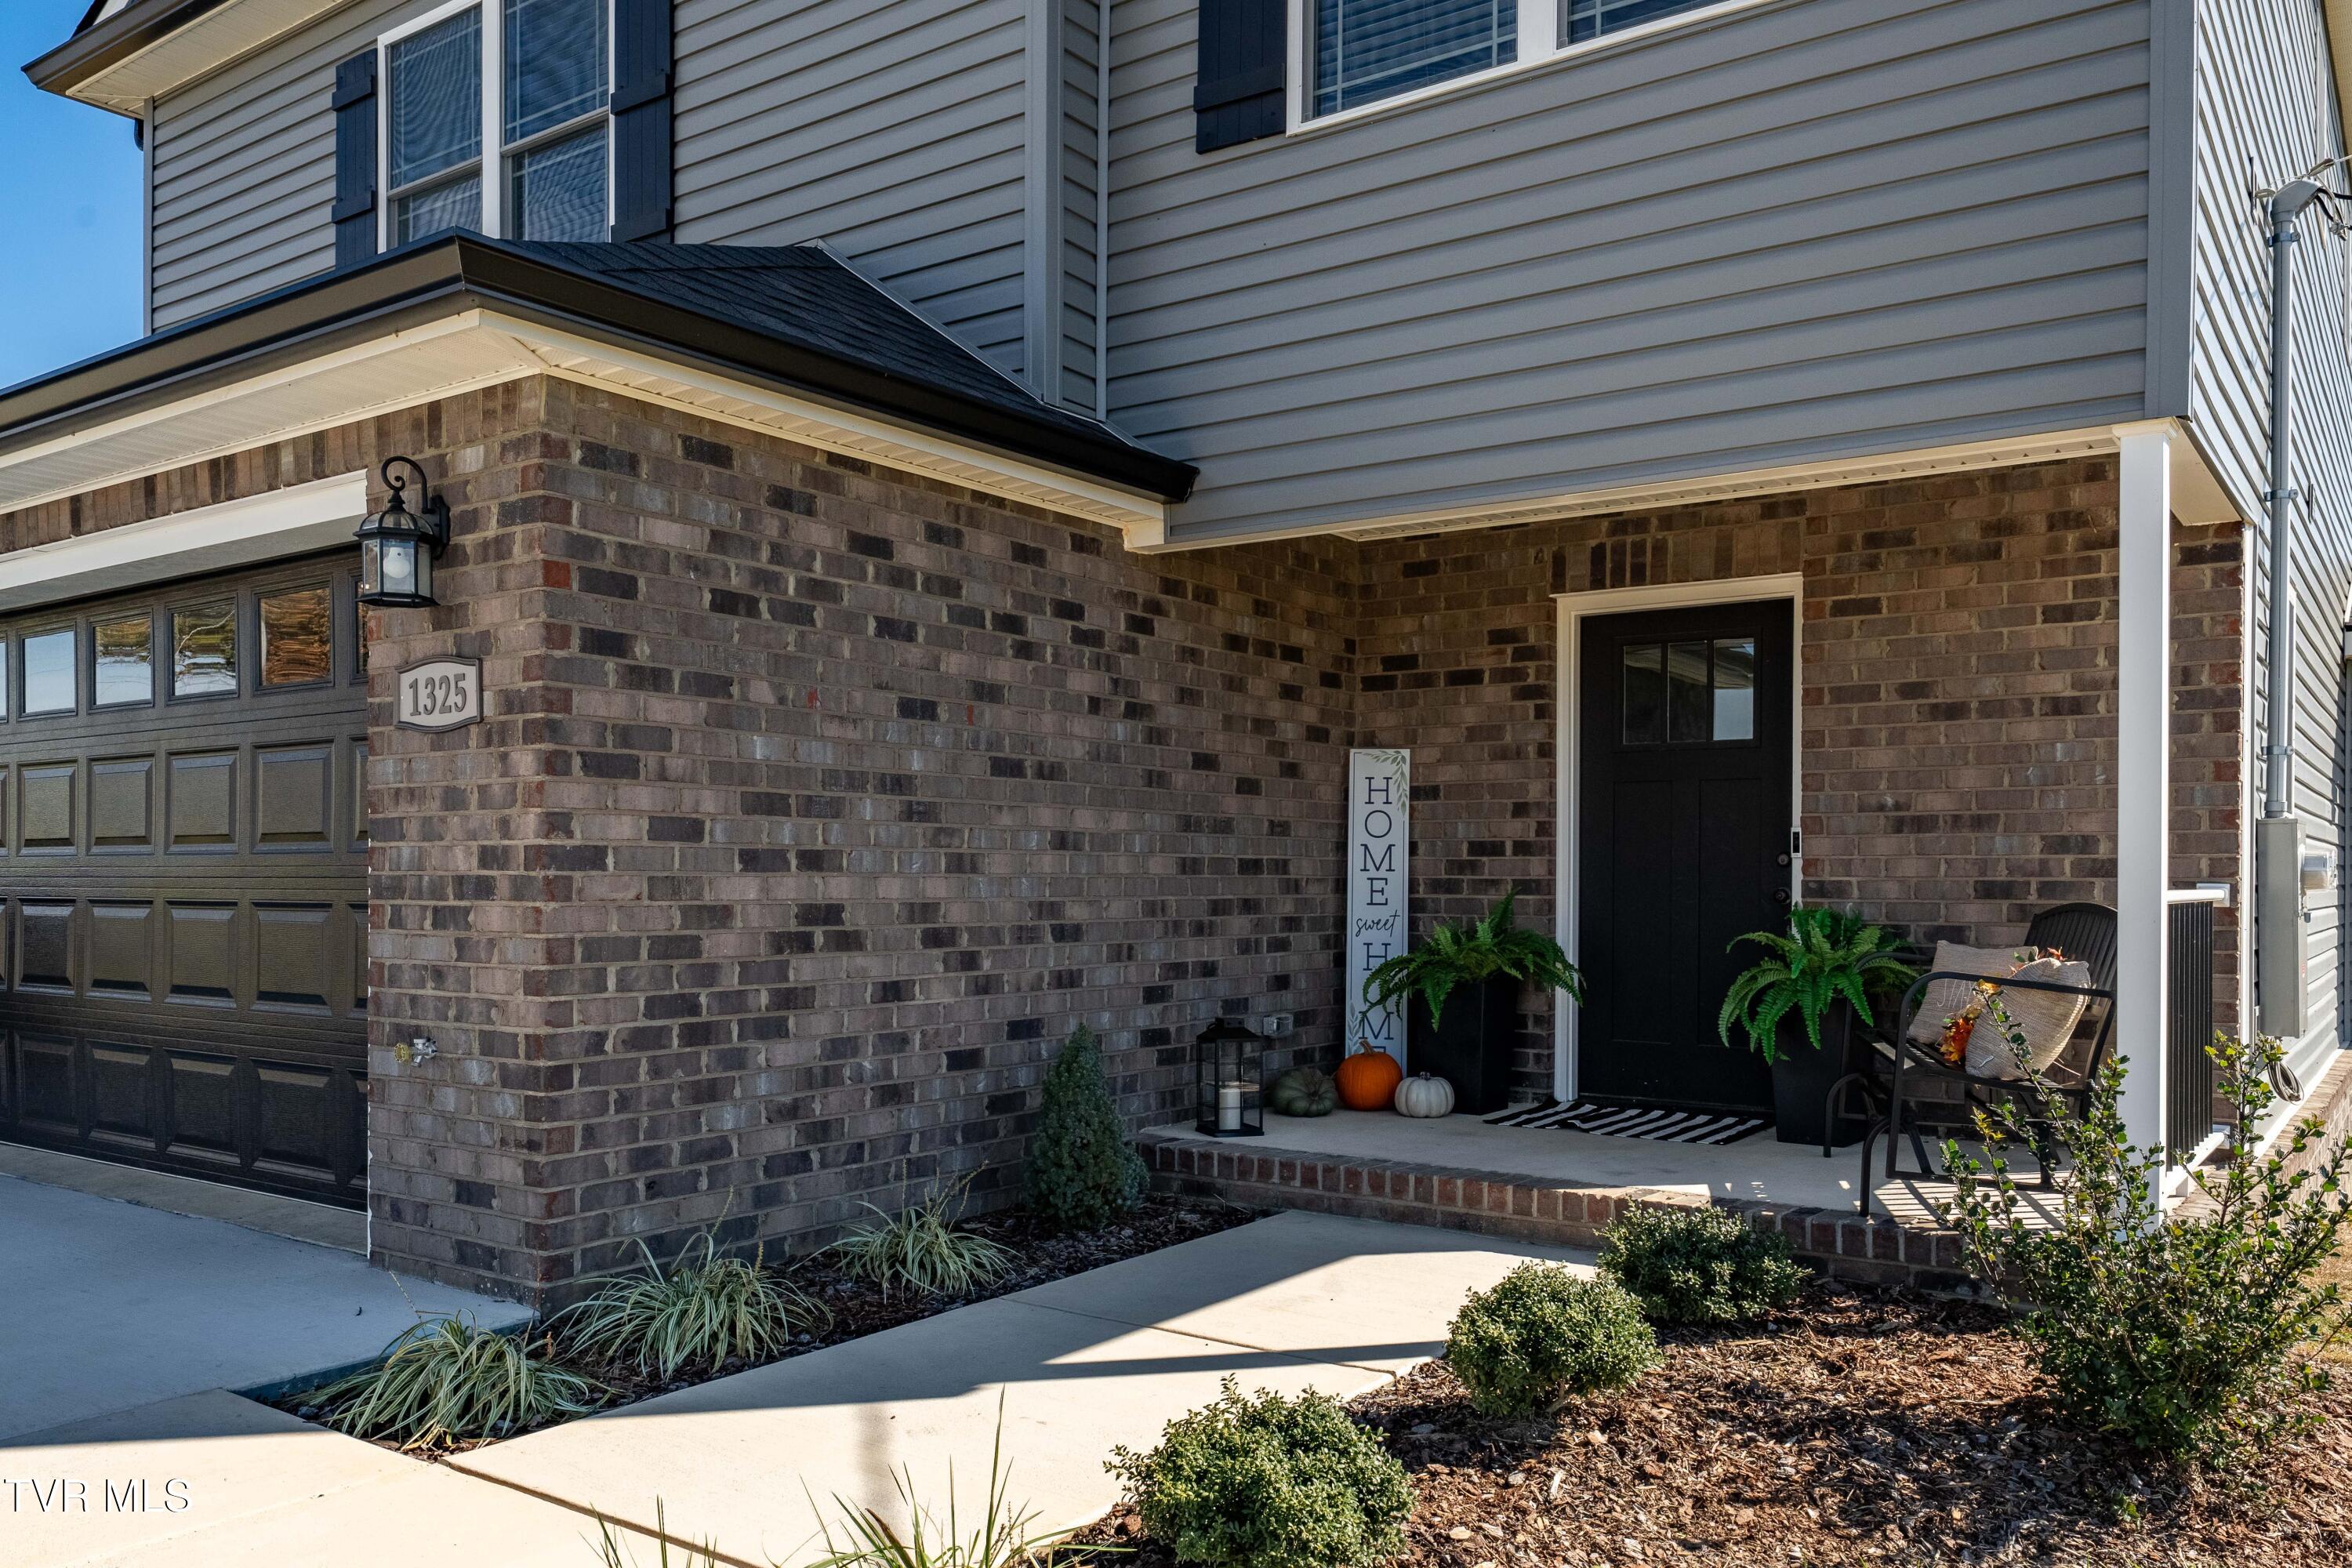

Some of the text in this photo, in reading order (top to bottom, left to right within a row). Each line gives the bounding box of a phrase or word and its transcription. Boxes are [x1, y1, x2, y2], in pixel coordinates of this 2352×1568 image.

[408, 673, 466, 717] 1325
[1360, 777, 1396, 906] HOME
[1356, 909, 1400, 938] sweet
[1359, 942, 1395, 1054] HM
